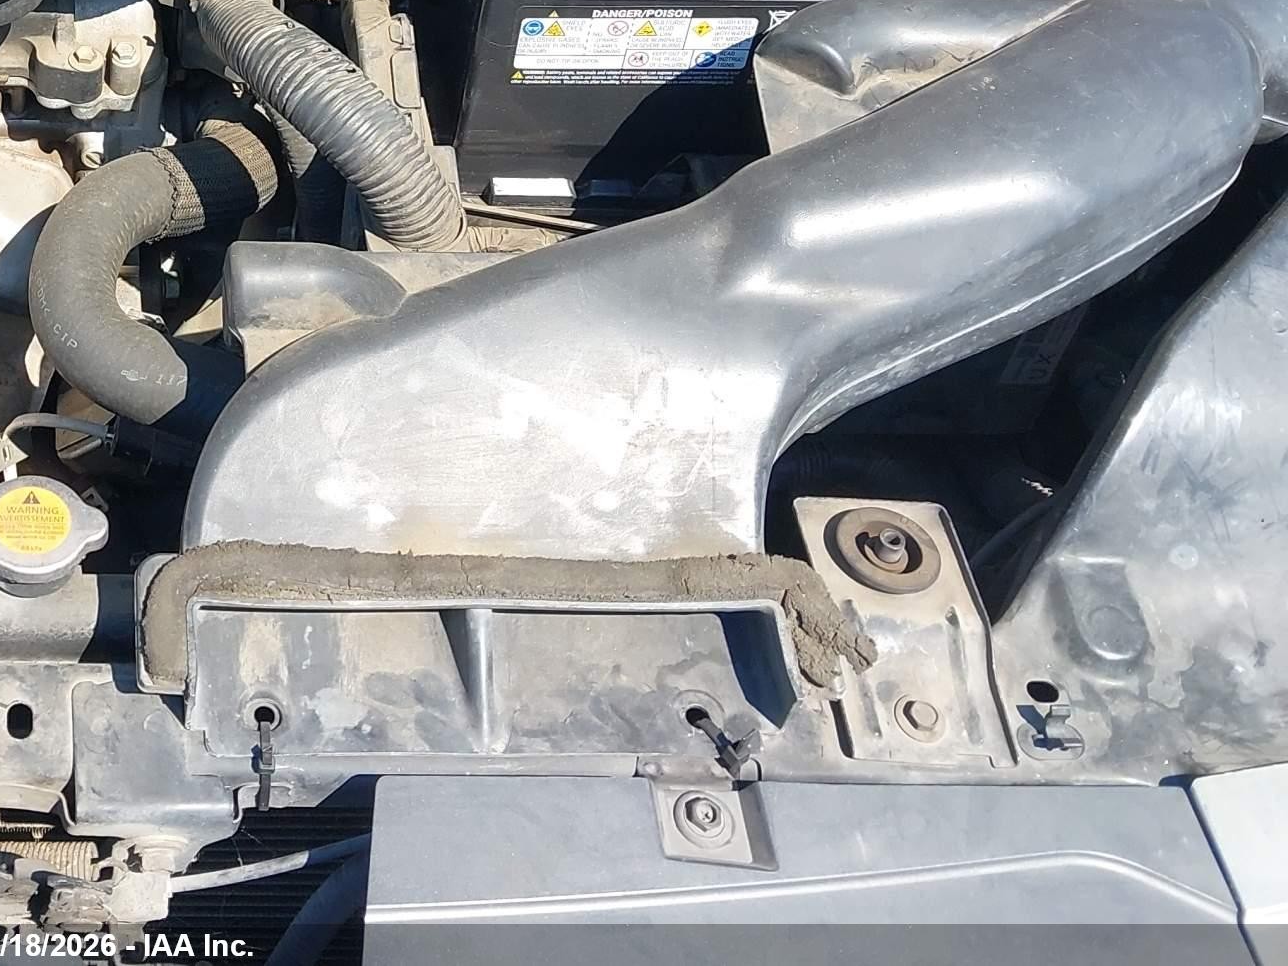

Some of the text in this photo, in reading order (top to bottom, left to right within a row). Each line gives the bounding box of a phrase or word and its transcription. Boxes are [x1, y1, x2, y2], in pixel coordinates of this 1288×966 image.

[592, 10, 693, 18] DANGER/POISON
[54, 324, 78, 348] CIP
[6, 506, 59, 514] WARNING
